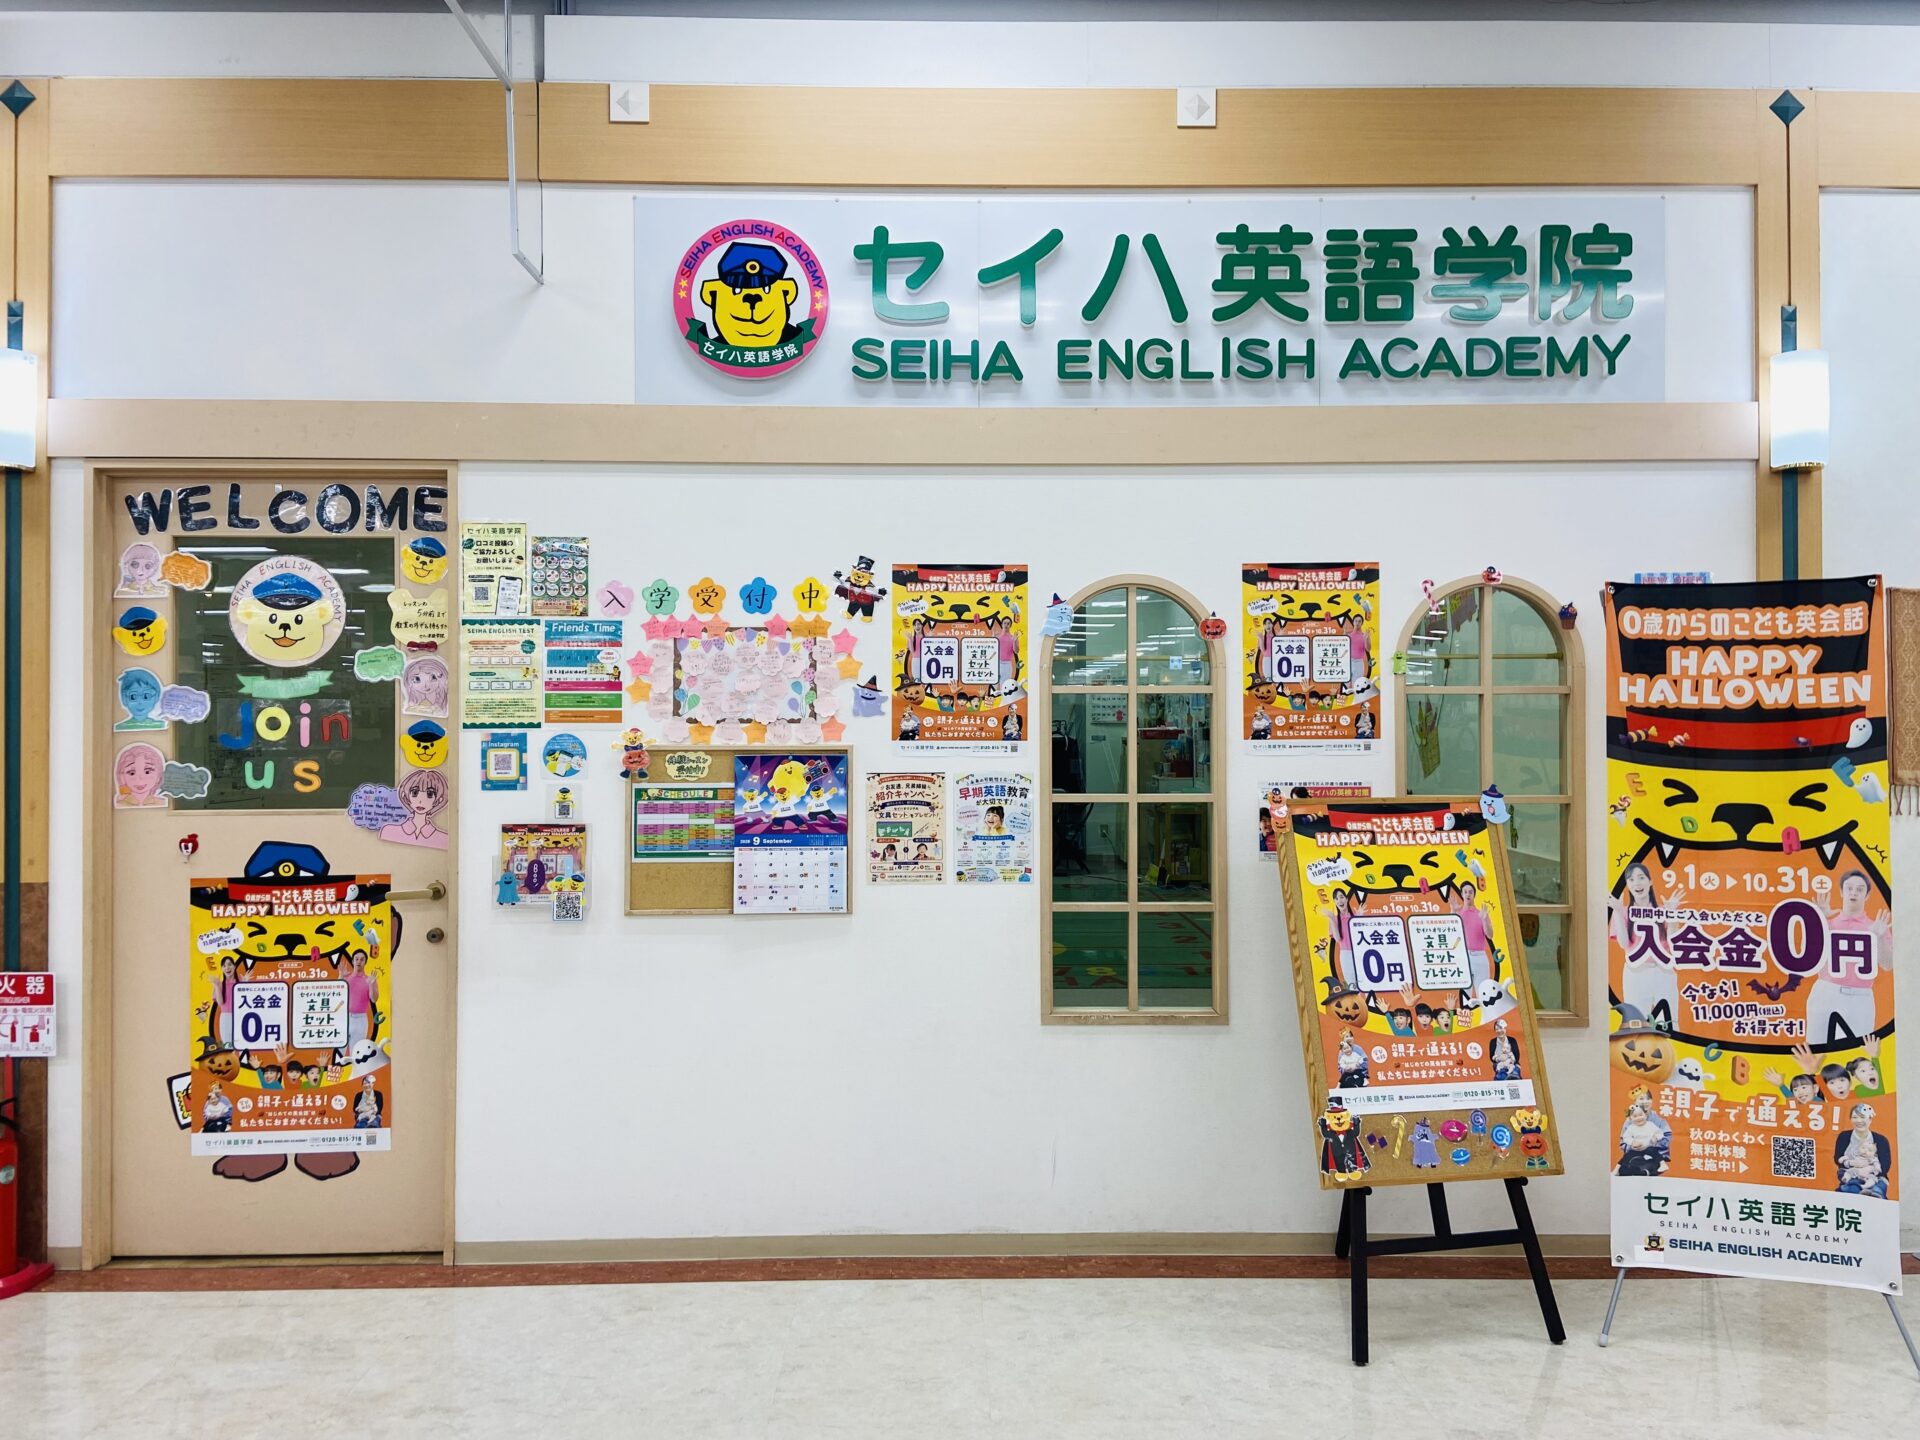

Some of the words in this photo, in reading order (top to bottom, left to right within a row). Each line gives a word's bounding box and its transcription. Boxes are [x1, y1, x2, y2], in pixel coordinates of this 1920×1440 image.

[680, 240, 711, 279] SEIHA
[711, 222, 775, 244] ENGLISH
[774, 231, 825, 290] ACADEMY
[852, 223, 1635, 326] セイハ英語学院
[702, 340, 799, 364] セイハ英語学院
[850, 338, 1023, 382] SEIHA
[1057, 336, 1316, 382] ENGLISH
[1338, 333, 1632, 381] ACADEMY
[124, 482, 448, 536] WELCOME
[475, 539, 514, 547] 口コミ投稿の
[472, 548, 516, 556] ご協力よろしく
[258, 560, 313, 576] ENGLISH
[318, 575, 342, 622] ACADEMY
[907, 582, 946, 593] HAPPY
[948, 582, 1014, 593] HALLOWEEN
[1256, 581, 1295, 591] HAPPY
[1298, 581, 1365, 591] HALLOWEEN
[604, 582, 820, 610] 入学受付中
[552, 622, 590, 633] Friends
[592, 622, 616, 633] Time
[1622, 604, 1865, 636] 0歳からのこども英会話
[924, 645, 955, 657] 入会金
[1275, 644, 1306, 655] 入会金
[926, 657, 954, 680] 0円
[968, 660, 991, 669] セット
[1277, 656, 1305, 678] 0円
[1320, 658, 1342, 667] セット
[1671, 648, 1817, 677] HAPPY
[966, 671, 994, 679] プレゼント
[1317, 668, 1346, 677] プレゼント
[1619, 674, 1873, 705] HALLOWEEN
[218, 700, 351, 749] Join
[243, 760, 323, 793] us
[657, 789, 709, 798] SCHEDULE
[875, 790, 939, 801] 紹介キャンペーン
[959, 785, 1030, 801] 早期英語教育
[975, 798, 1013, 806] が大切です!
[753, 836, 760, 846] 9
[1316, 833, 1373, 847] HAPPY
[1376, 831, 1470, 846] HALLOWEEN
[1662, 863, 1721, 891] 9.1火
[1742, 866, 1833, 894] 10.31土
[212, 904, 269, 918] HAPPY
[272, 902, 370, 916] HALLOWEEN
[1630, 908, 1764, 924] 期間中にご入会いただくと
[1356, 929, 1401, 947] 入会金
[1424, 934, 1449, 949] 文具
[1424, 951, 1455, 963] セット
[1362, 948, 1406, 984] 0円
[1421, 967, 1464, 979] プレゼント
[1682, 979, 1738, 1003] 今なら!
[238, 994, 282, 1009] 入会金
[306, 998, 331, 1012] 文具
[302, 1013, 335, 1025] セット
[1693, 1003, 1785, 1023] 11,000円(税込)
[241, 1012, 282, 1043] 0円
[299, 1029, 341, 1039] プレゼント
[1733, 1018, 1805, 1037] お得です!
[1391, 1041, 1463, 1058] 親子で通える!
[1376, 1068, 1482, 1081] 私たちにおまかせください!
[257, 1094, 328, 1108] 親子で通える!
[1463, 1089, 1505, 1098] 0120-815-718
[1659, 1087, 1841, 1131] 親子で通える!
[239, 1117, 343, 1128] 私たちにおまかせください!
[1689, 1127, 1766, 1147] 秋のわくわく
[1689, 1142, 1747, 1160] 無料体験
[1689, 1158, 1736, 1173] 実施中!
[1643, 1191, 1863, 1233] セイハ英語学院
[1660, 1219, 1698, 1231] SEIHA
[1713, 1224, 1771, 1238] ENGLISH
[1786, 1231, 1850, 1246] ACADEMY
[1668, 1237, 1713, 1252] SEIHA
[1718, 1242, 1782, 1259] ENGLISH
[1787, 1248, 1863, 1268] ACADEMY
